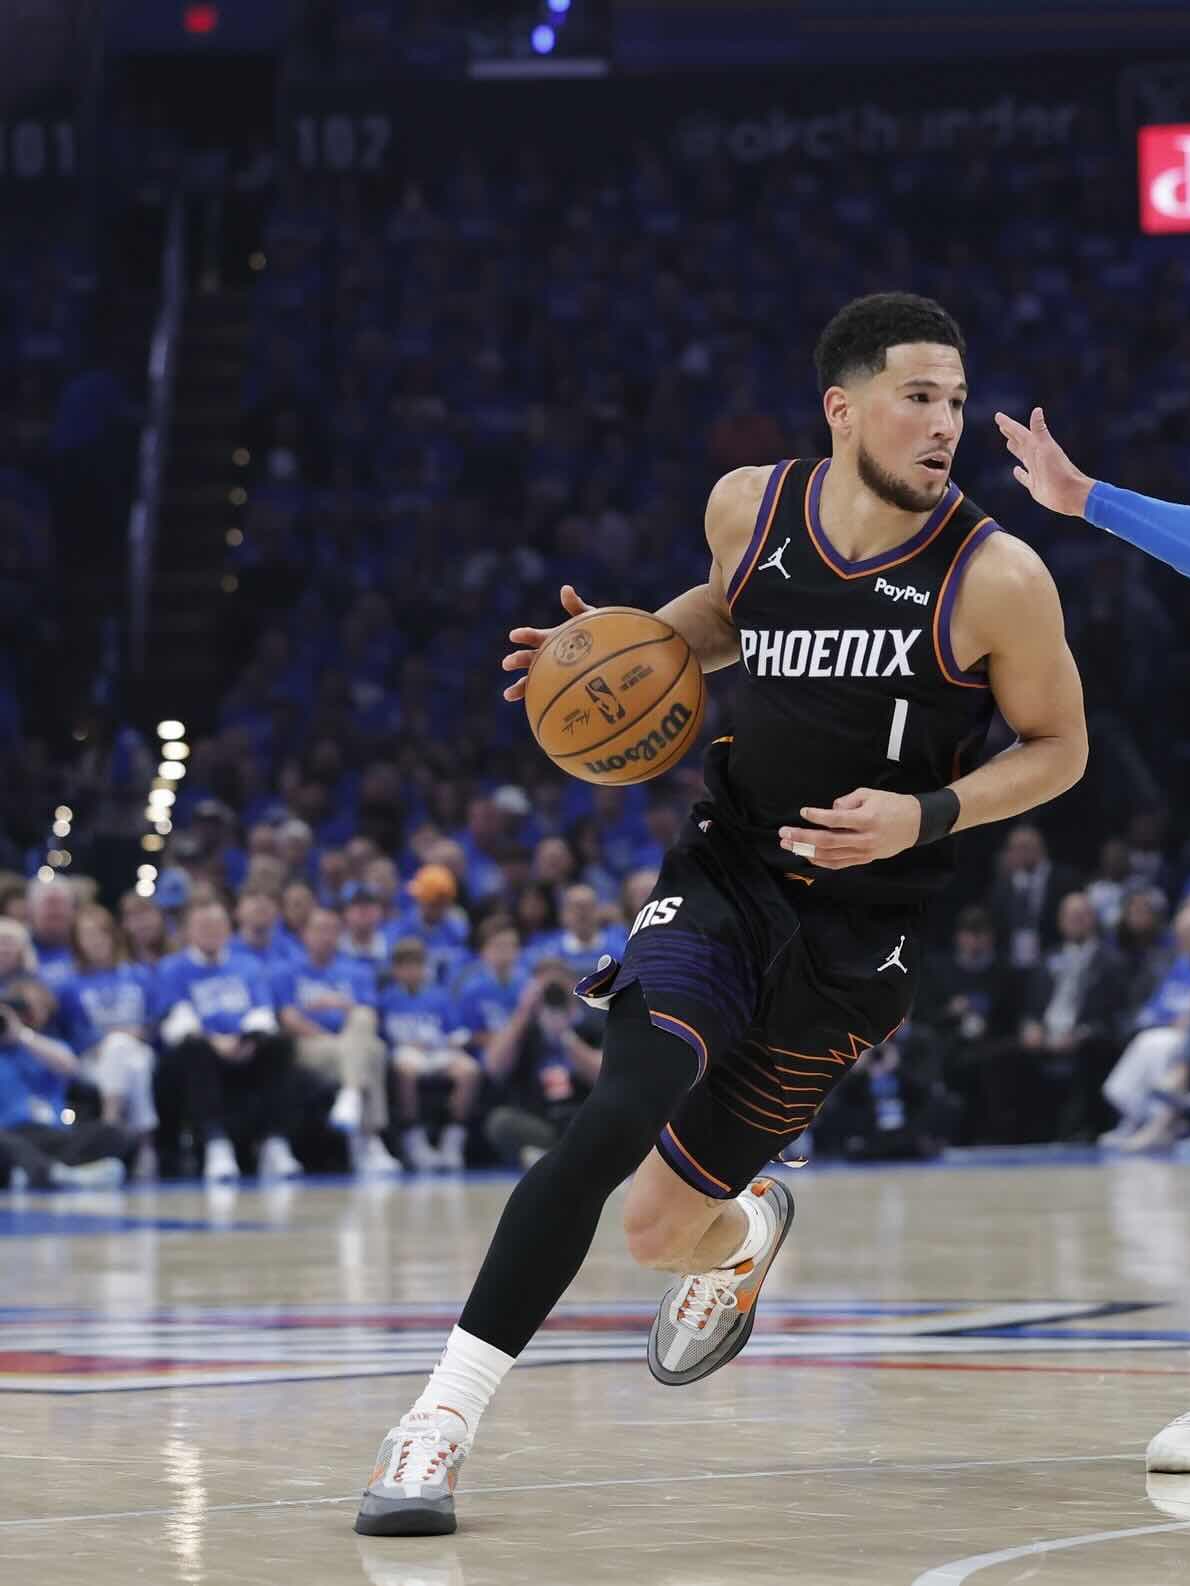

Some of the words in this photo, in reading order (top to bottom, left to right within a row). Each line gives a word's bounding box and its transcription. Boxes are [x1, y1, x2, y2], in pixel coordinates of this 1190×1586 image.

[293, 113, 392, 170] 102
[874, 577, 930, 606] PayPal
[740, 628, 922, 677] PHOENIX
[584, 702, 694, 774] Wilson
[887, 698, 908, 761] 1
